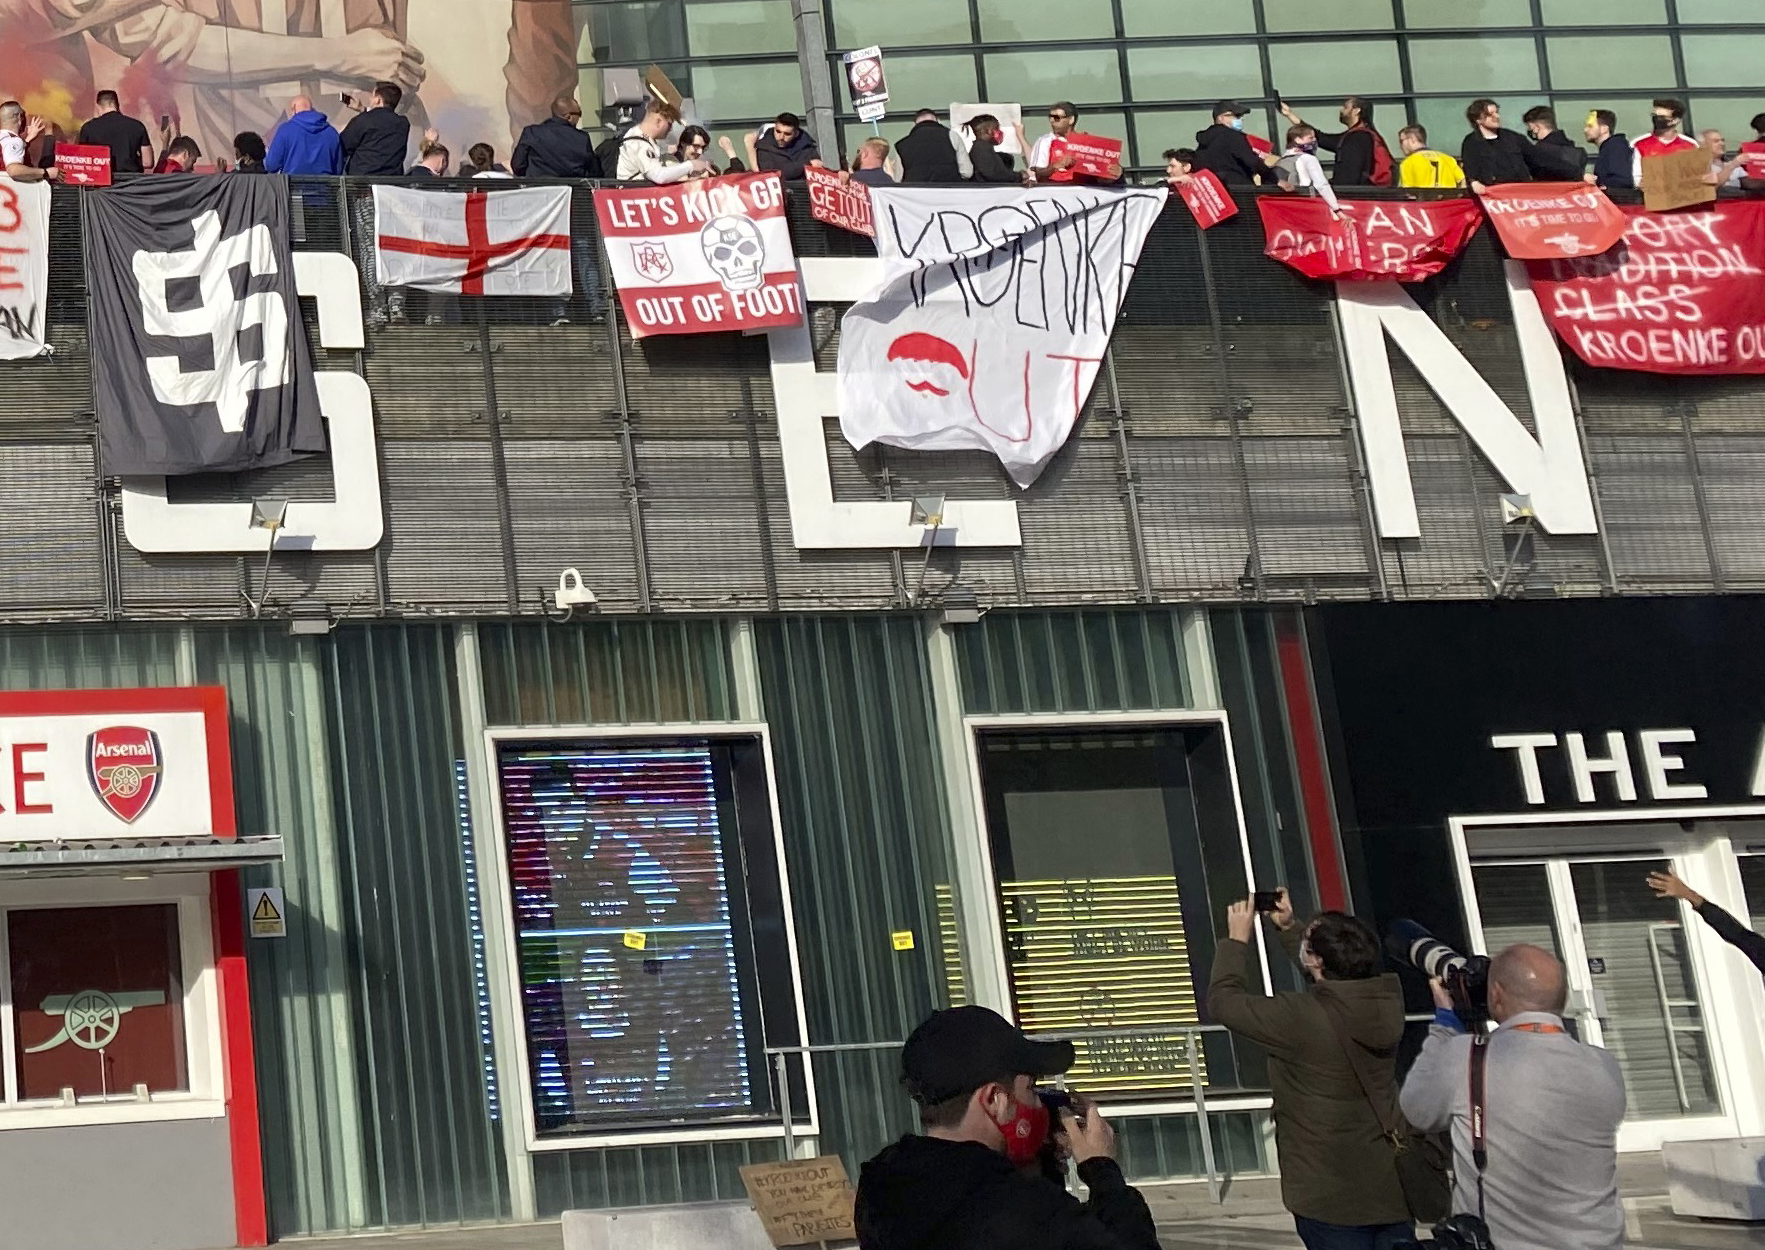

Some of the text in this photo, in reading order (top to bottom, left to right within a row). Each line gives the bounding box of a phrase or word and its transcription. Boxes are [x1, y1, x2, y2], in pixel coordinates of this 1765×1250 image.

[606, 195, 680, 229] LET'S
[681, 183, 749, 224] KICK
[809, 182, 847, 215] GET
[845, 194, 872, 224] OUT
[1484, 197, 1572, 215] KROENKE
[1541, 213, 1566, 225] TIME
[1566, 212, 1583, 223] TO
[636, 281, 803, 326] OUT OF FOOT
[1553, 284, 1704, 323] CLASS
[1573, 325, 1728, 365] KROENKE
[94, 739, 152, 758] Arsenal
[1491, 727, 1708, 805] THE
